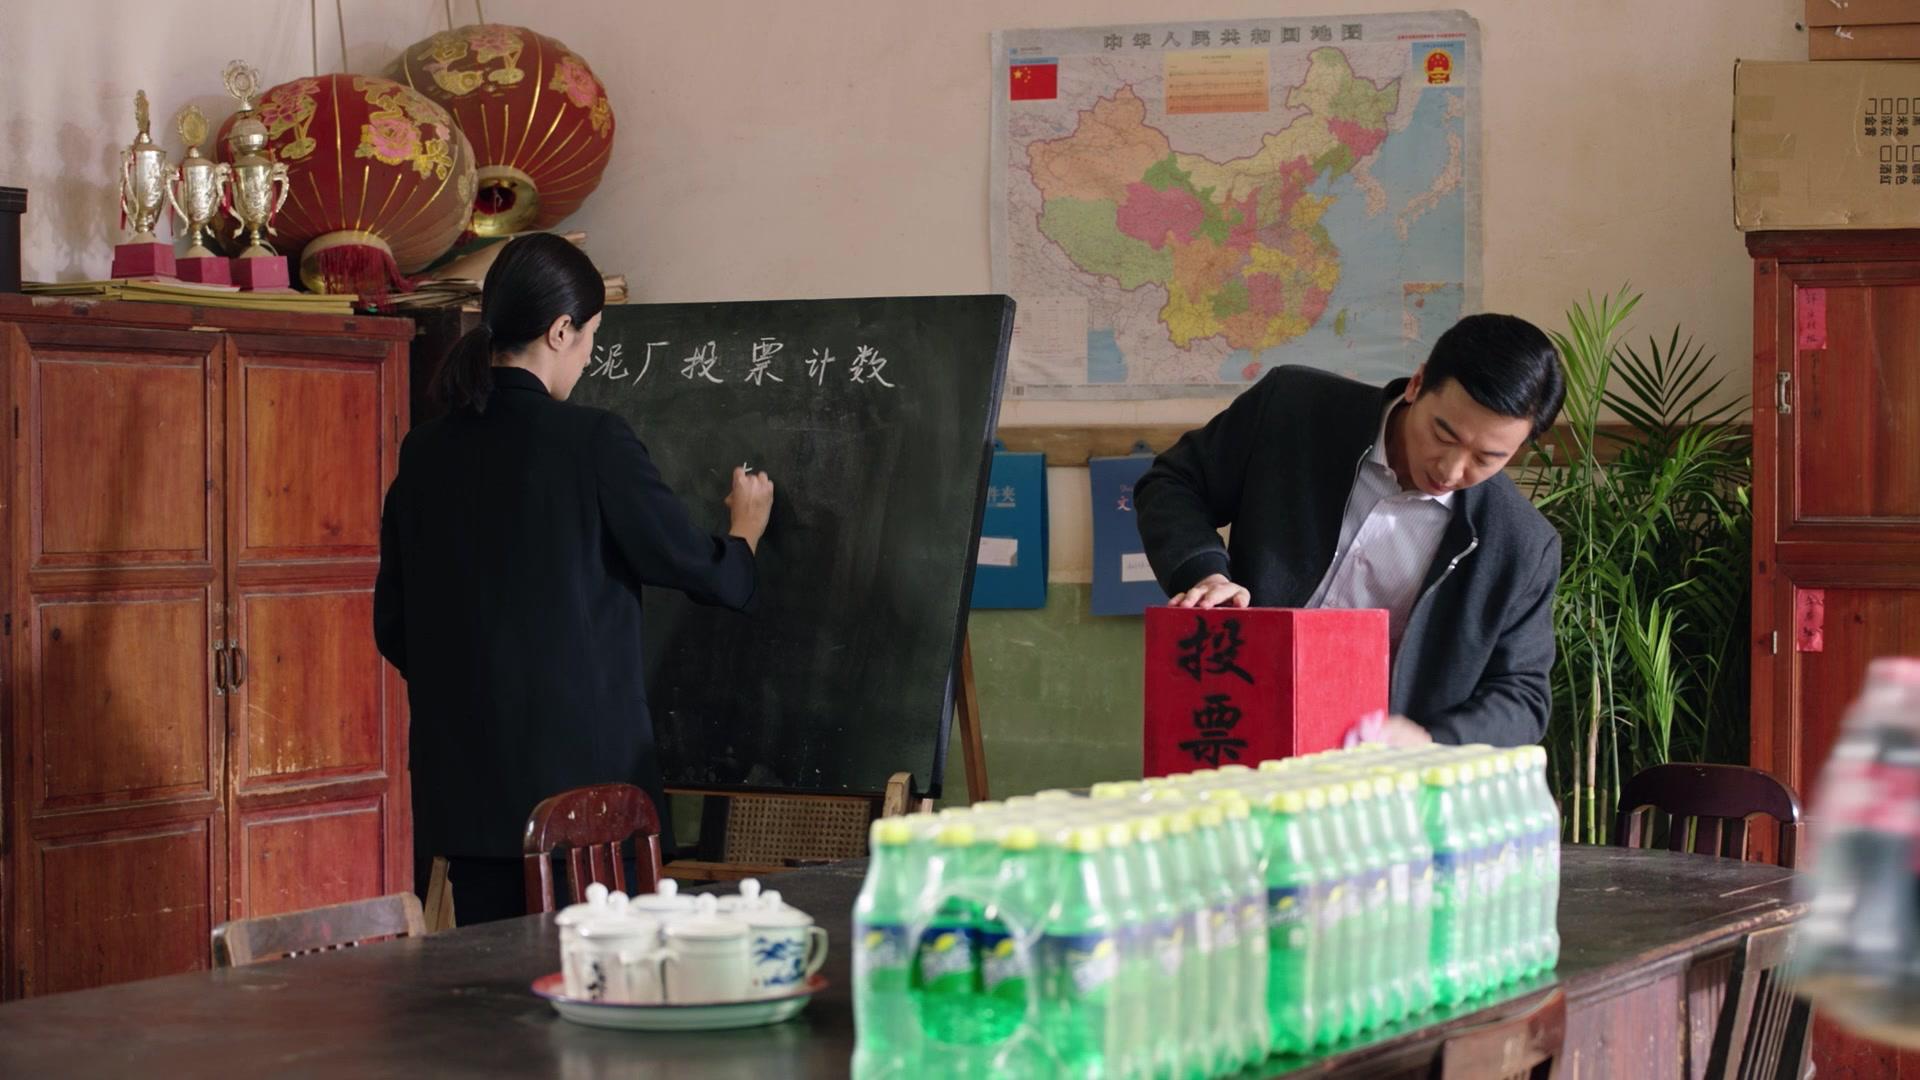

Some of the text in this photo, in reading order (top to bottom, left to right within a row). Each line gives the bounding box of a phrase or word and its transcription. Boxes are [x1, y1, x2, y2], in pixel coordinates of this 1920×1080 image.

[1103, 23, 1363, 51] 中华人民共和国地图
[1897, 115, 1909, 136] 米黄
[590, 337, 896, 388] 泥厂投票计数
[1177, 615, 1255, 767] 投票
